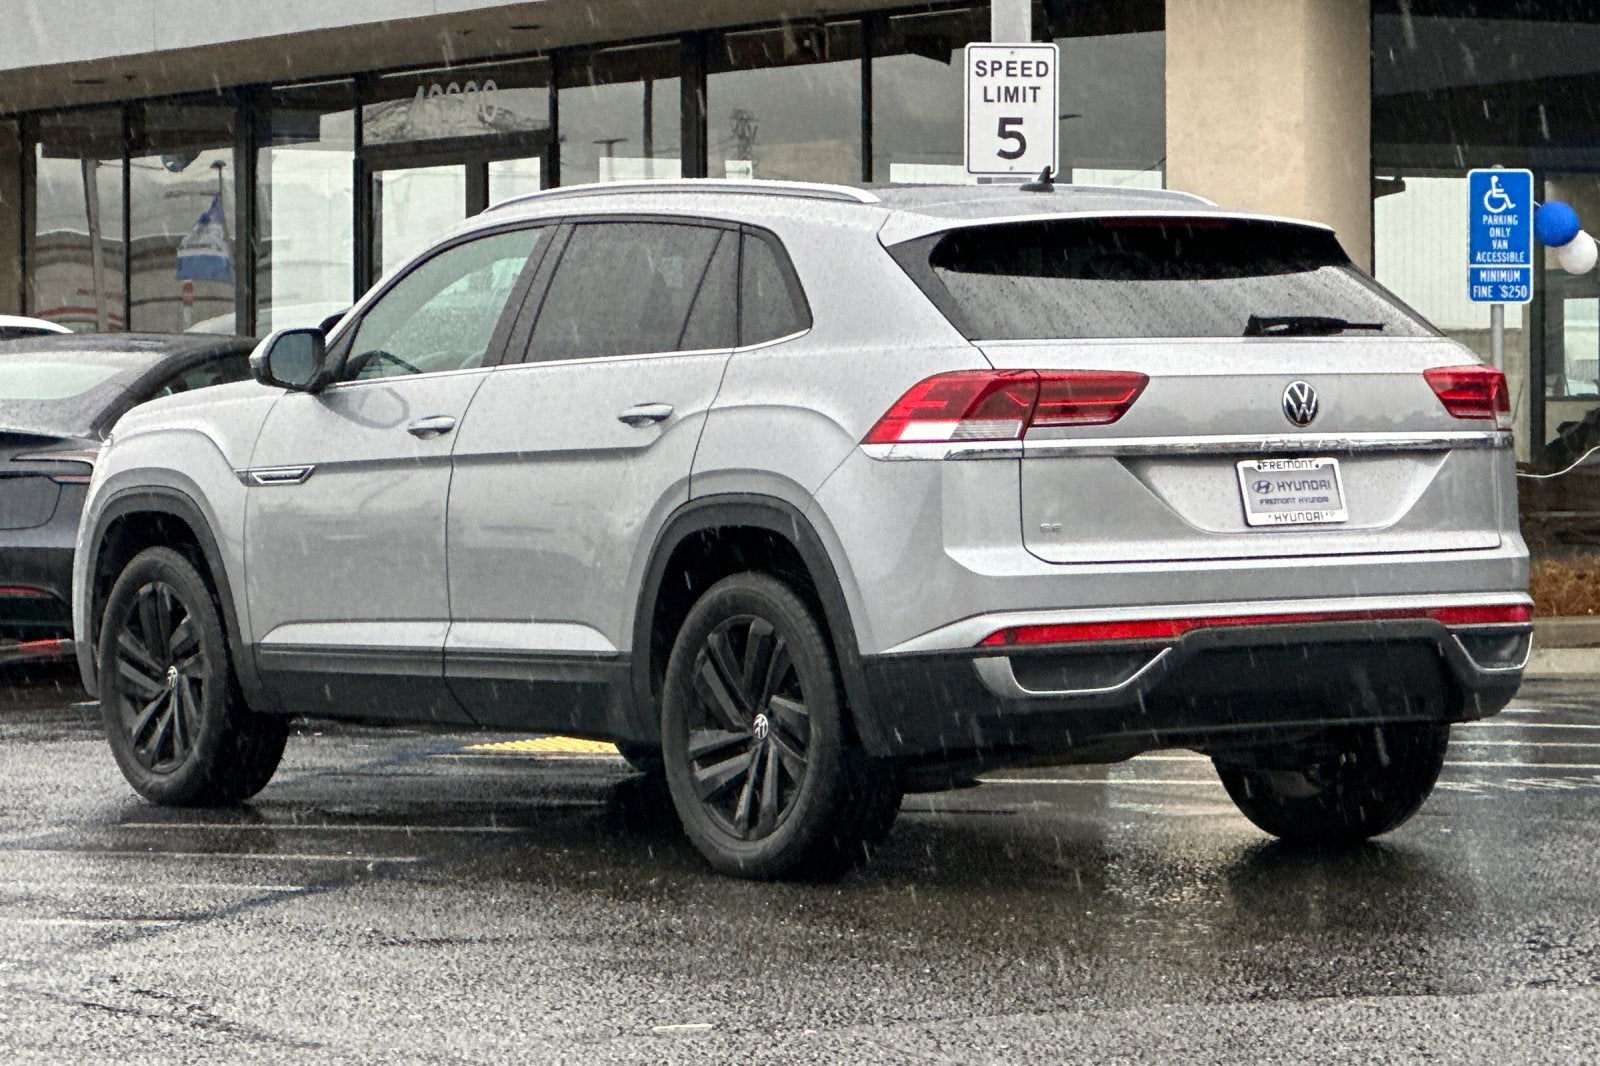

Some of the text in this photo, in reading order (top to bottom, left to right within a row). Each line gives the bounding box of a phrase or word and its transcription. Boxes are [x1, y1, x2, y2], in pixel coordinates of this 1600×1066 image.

[975, 60, 1049, 77] SPEED
[983, 86, 1041, 103] LIMIT
[997, 117, 1026, 160] 5
[1482, 214, 1518, 225] PARKING
[1489, 227, 1511, 237] ONLY
[1492, 239, 1508, 249] VAN
[1475, 251, 1525, 262] ACCESSIBLE
[1480, 270, 1520, 282] MINIMUM
[1473, 284, 1527, 298] FINE $250
[1262, 460, 1313, 470] FREMONT
[1276, 480, 1331, 491] HYUNDAI
[1274, 512, 1323, 522] HYUNDAI
